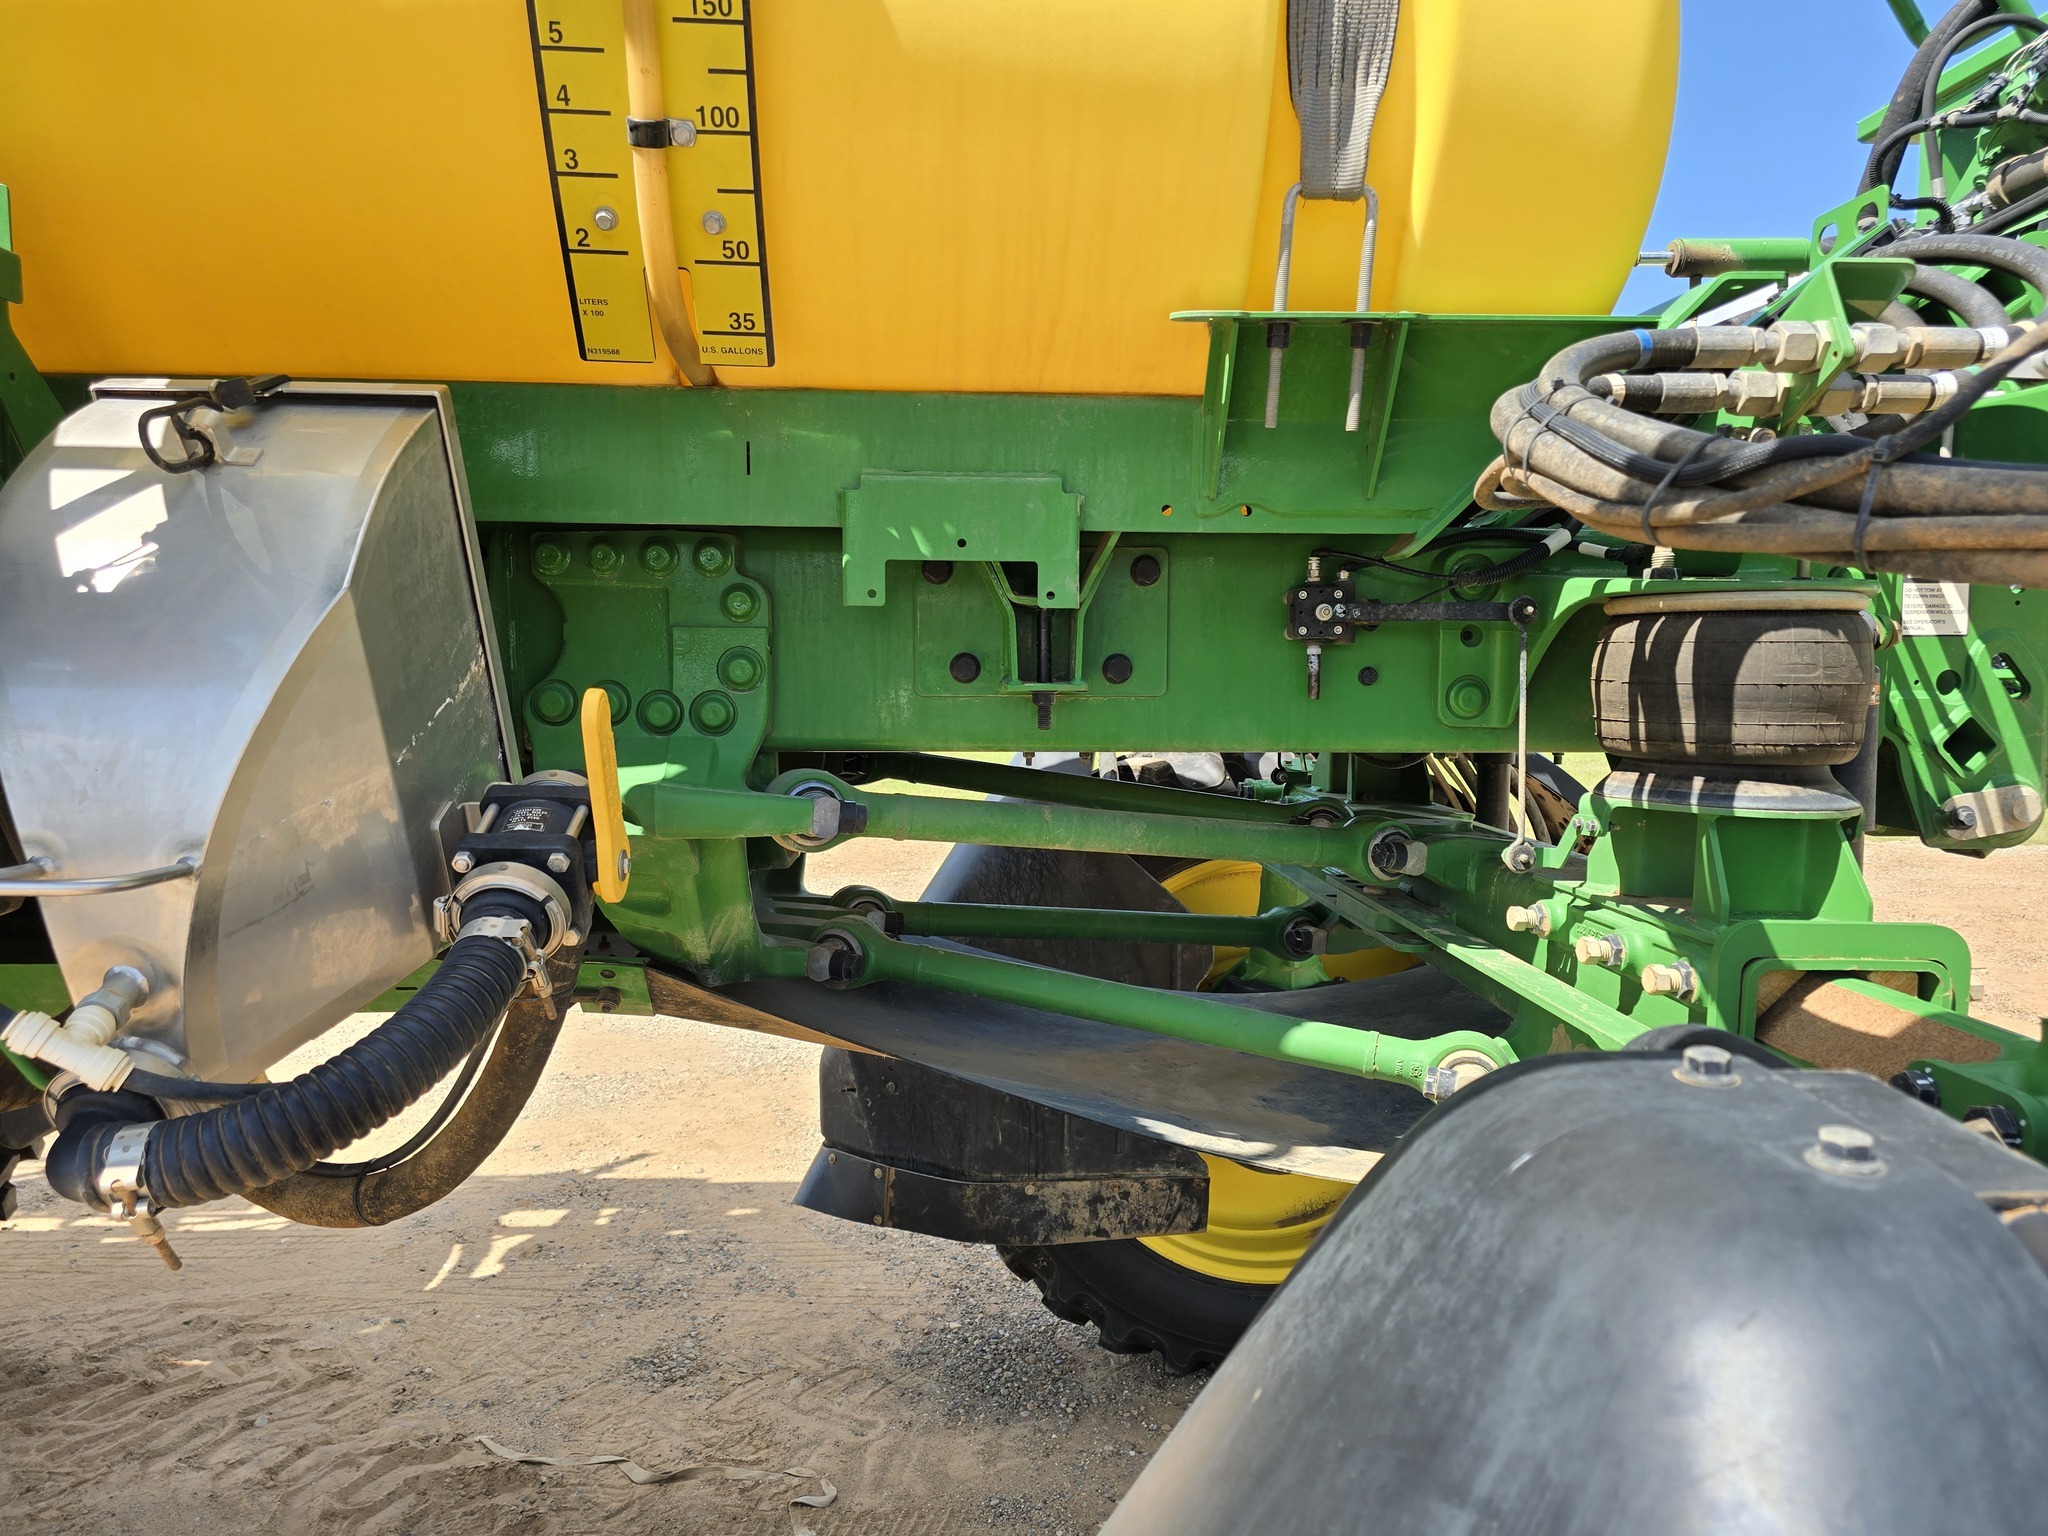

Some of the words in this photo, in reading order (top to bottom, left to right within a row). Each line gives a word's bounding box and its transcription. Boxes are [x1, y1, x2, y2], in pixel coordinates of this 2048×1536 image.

[691, 0, 733, 17] 150
[548, 20, 564, 44] 5
[556, 84, 571, 107] 4
[695, 105, 740, 128] 100
[563, 148, 579, 170] 3
[575, 227, 591, 248] 2
[722, 240, 750, 260] 50
[579, 298, 609, 306] LITERS
[582, 309, 589, 317] X
[590, 309, 605, 317] 100
[728, 312, 756, 331] 35
[701, 345, 719, 355] U.S.
[720, 346, 764, 356] GALLONS
